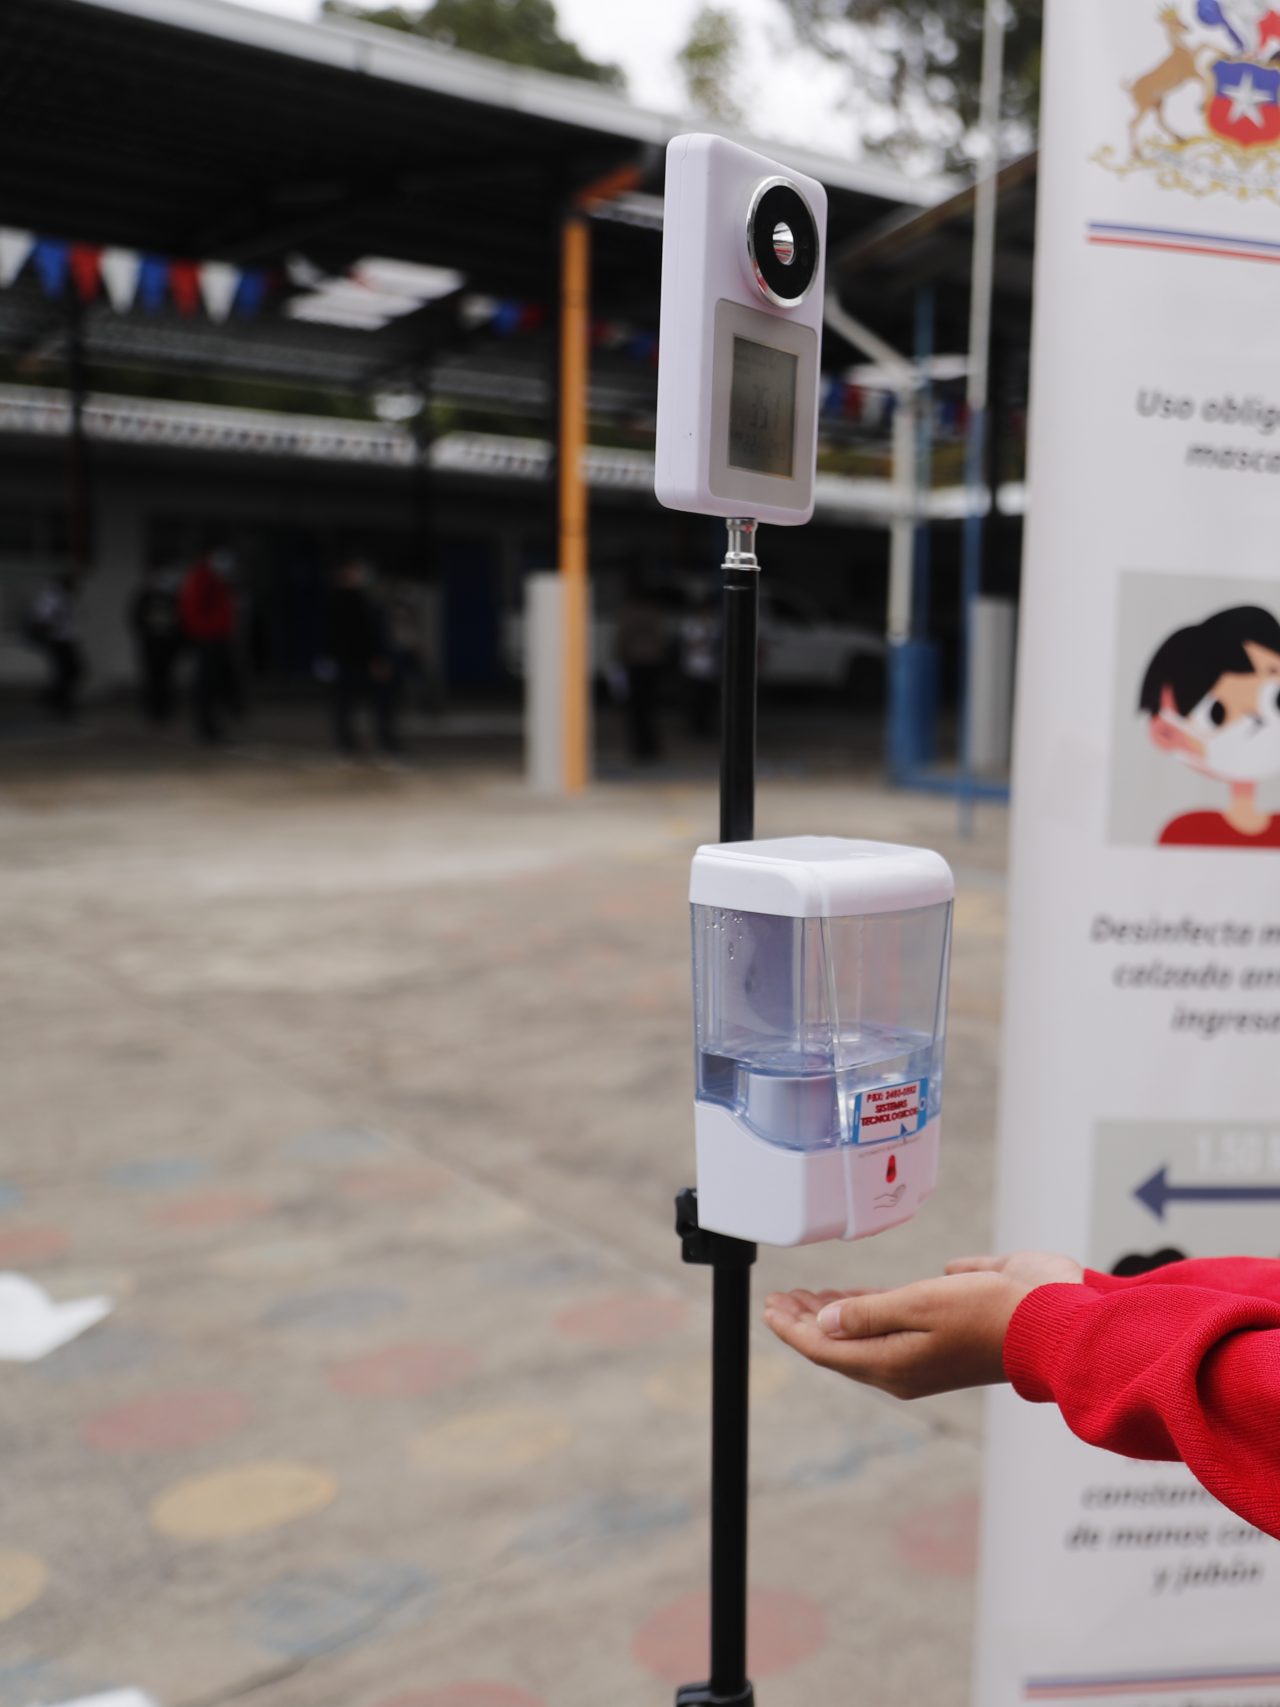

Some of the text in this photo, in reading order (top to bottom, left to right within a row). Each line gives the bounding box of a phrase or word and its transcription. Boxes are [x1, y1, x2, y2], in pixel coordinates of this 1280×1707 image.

[1137, 388, 1193, 420] Uso
[1091, 913, 1251, 946] Desinfecta
[1112, 959, 1231, 990] calzado
[1066, 1522, 1099, 1549] de
[1109, 1525, 1208, 1546] manos
